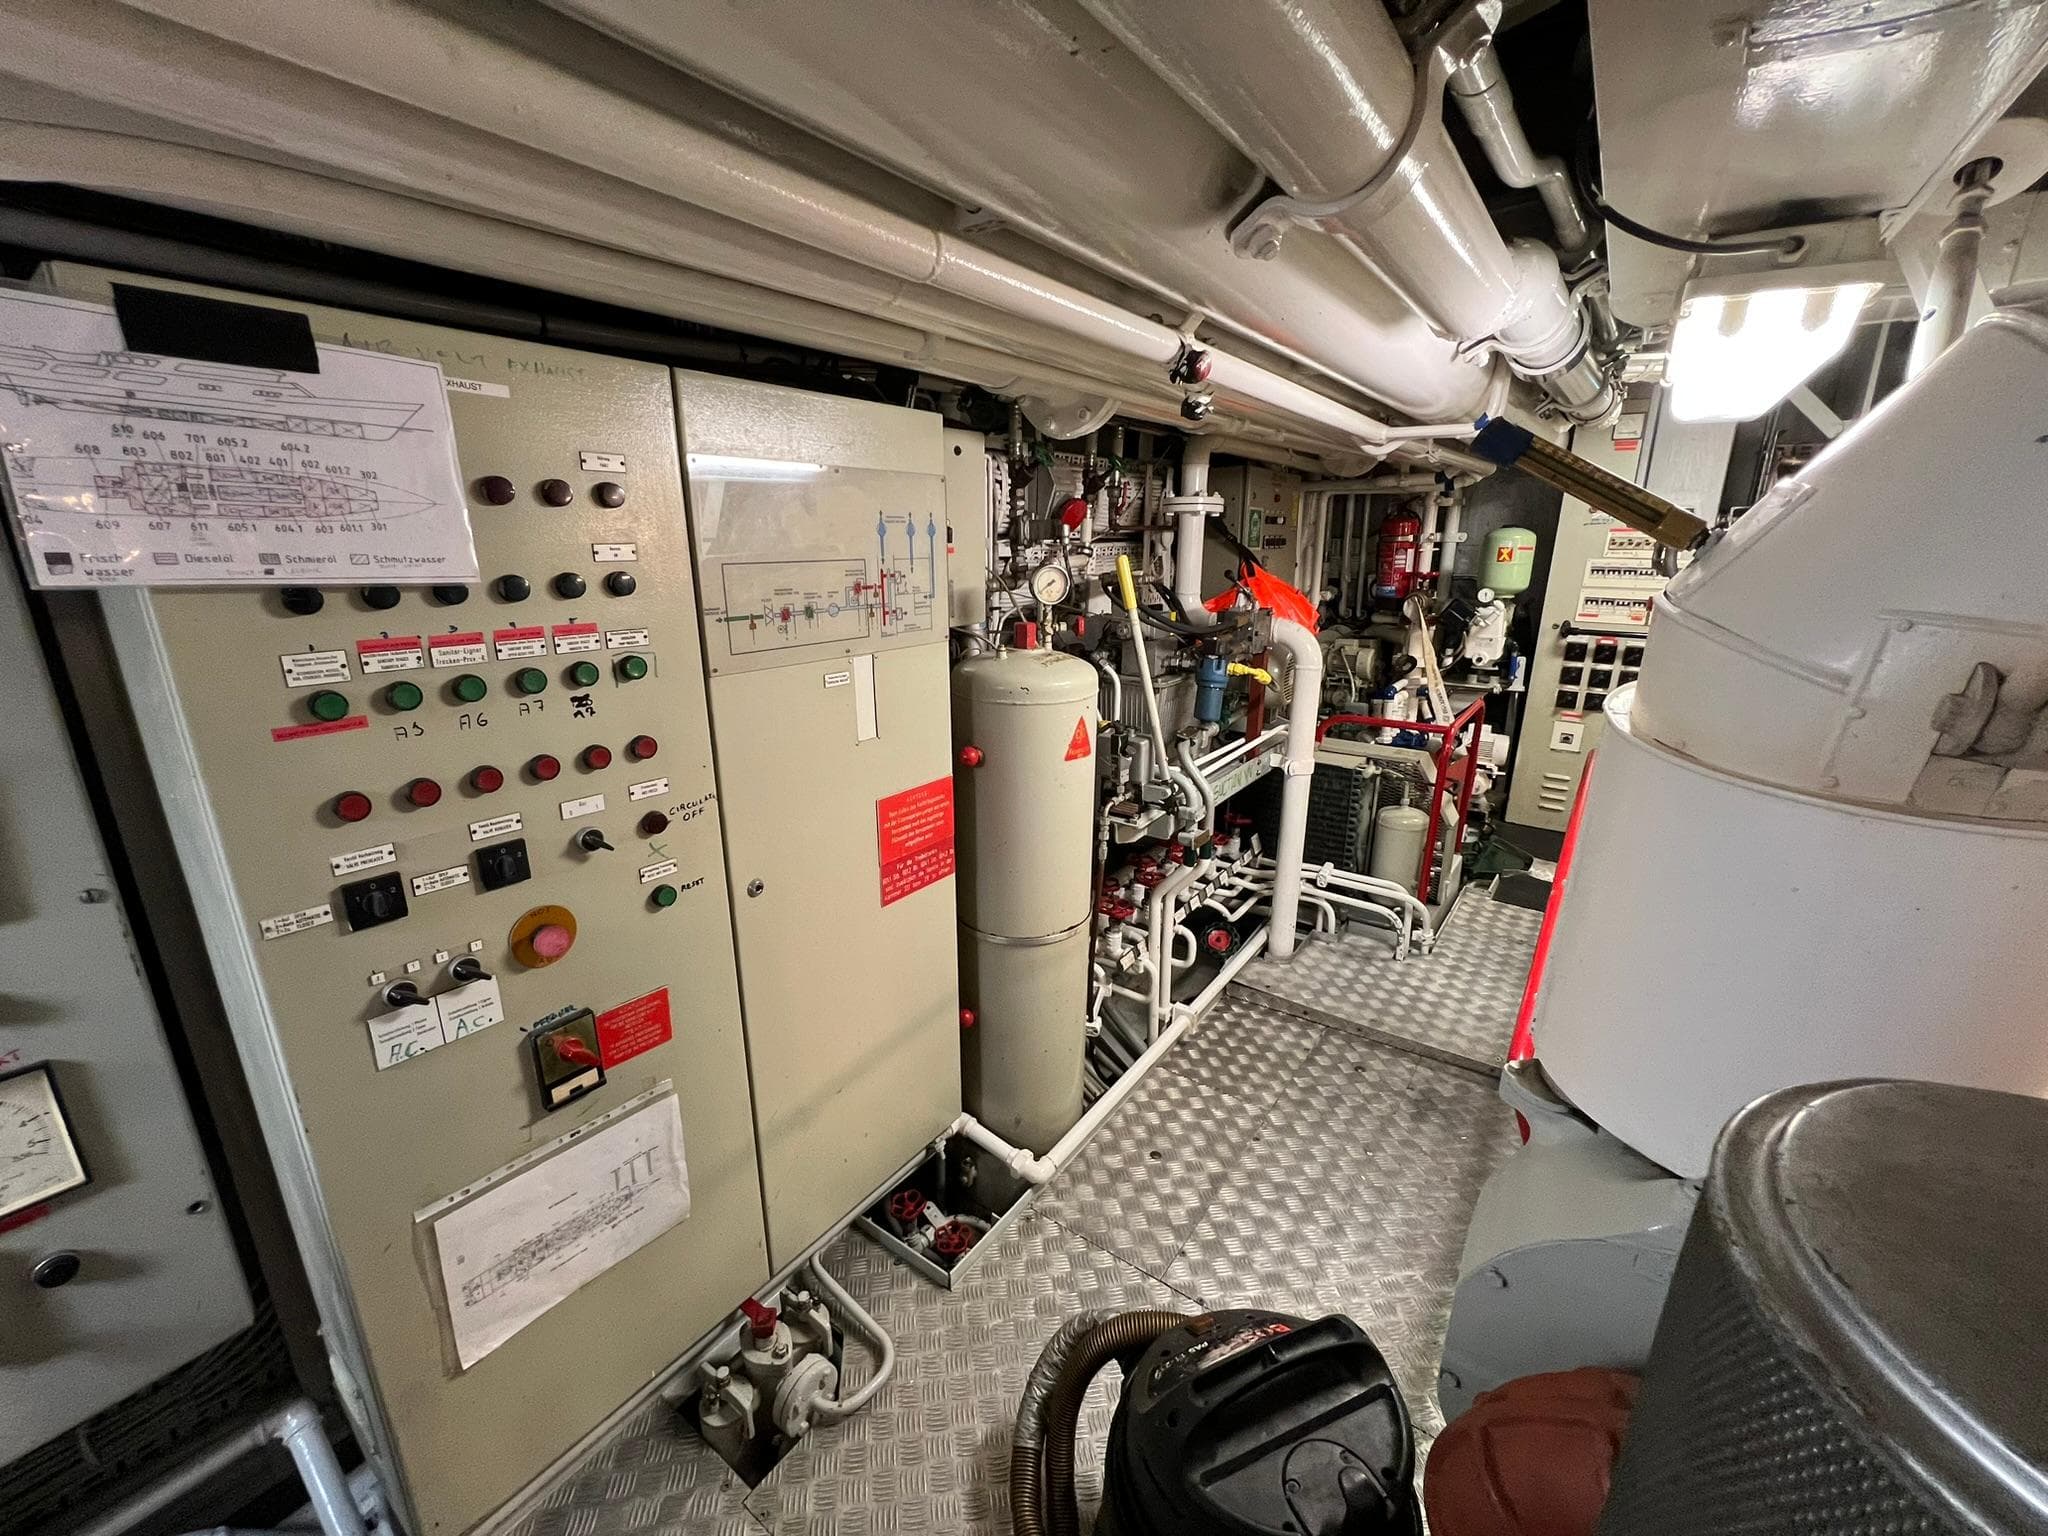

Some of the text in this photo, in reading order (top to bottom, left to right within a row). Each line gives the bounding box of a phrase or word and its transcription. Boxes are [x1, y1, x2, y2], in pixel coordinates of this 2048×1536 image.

[446, 379, 483, 392] XHAUST
[682, 806, 705, 822] OFF
[681, 877, 705, 892] RESET
